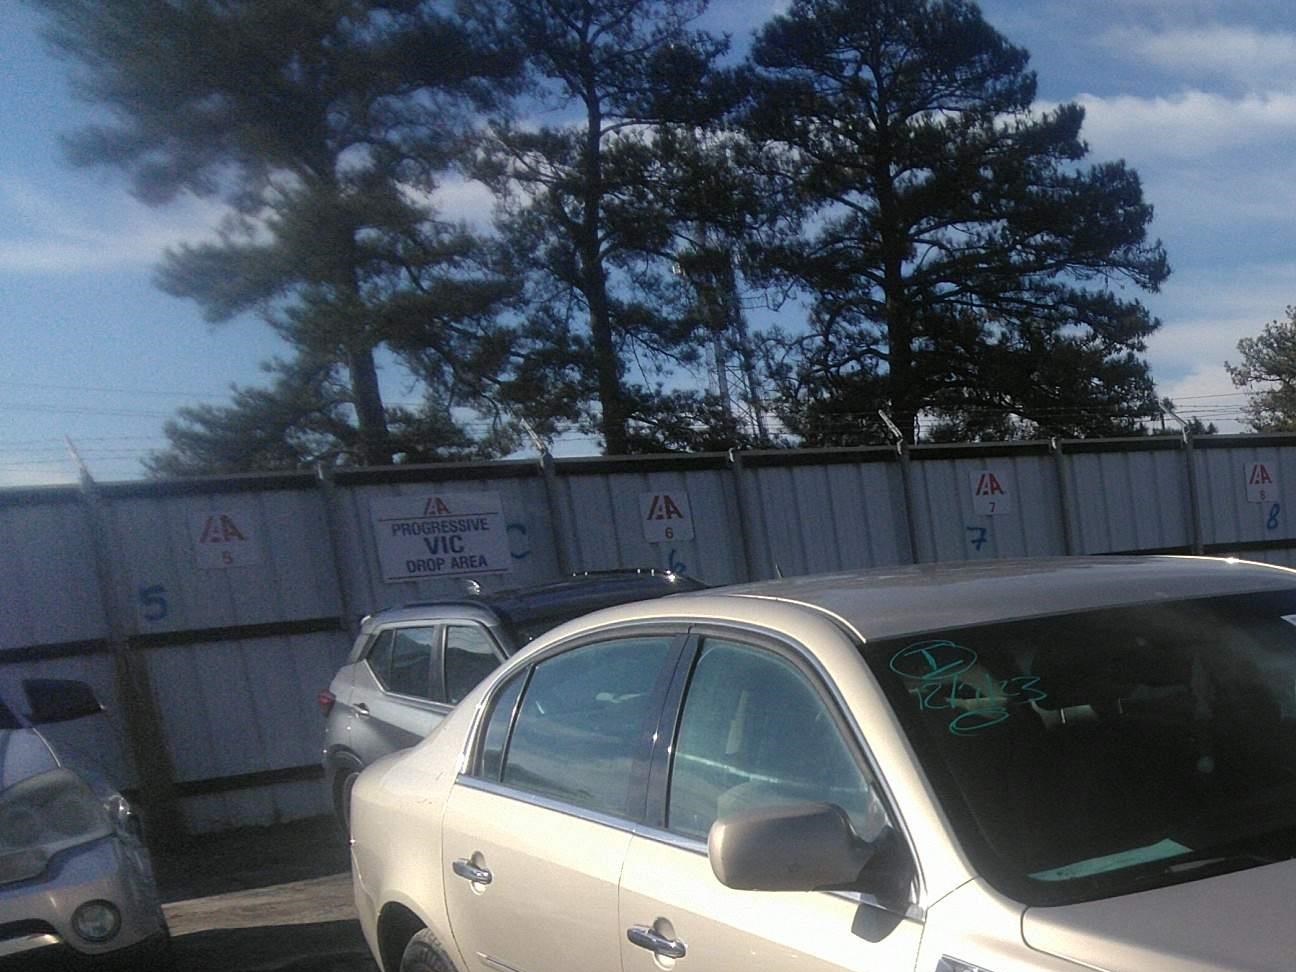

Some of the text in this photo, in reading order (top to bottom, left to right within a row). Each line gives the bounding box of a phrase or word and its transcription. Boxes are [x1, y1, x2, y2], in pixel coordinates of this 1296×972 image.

[988, 501, 996, 512] 7
[1267, 503, 1281, 530] 8
[391, 517, 490, 536] PROGRESSIVE
[664, 527, 674, 539] 6
[424, 534, 466, 555] VIC
[966, 525, 988, 552] 7
[406, 554, 489, 573] DROP AREA
[139, 583, 169, 622] 5
